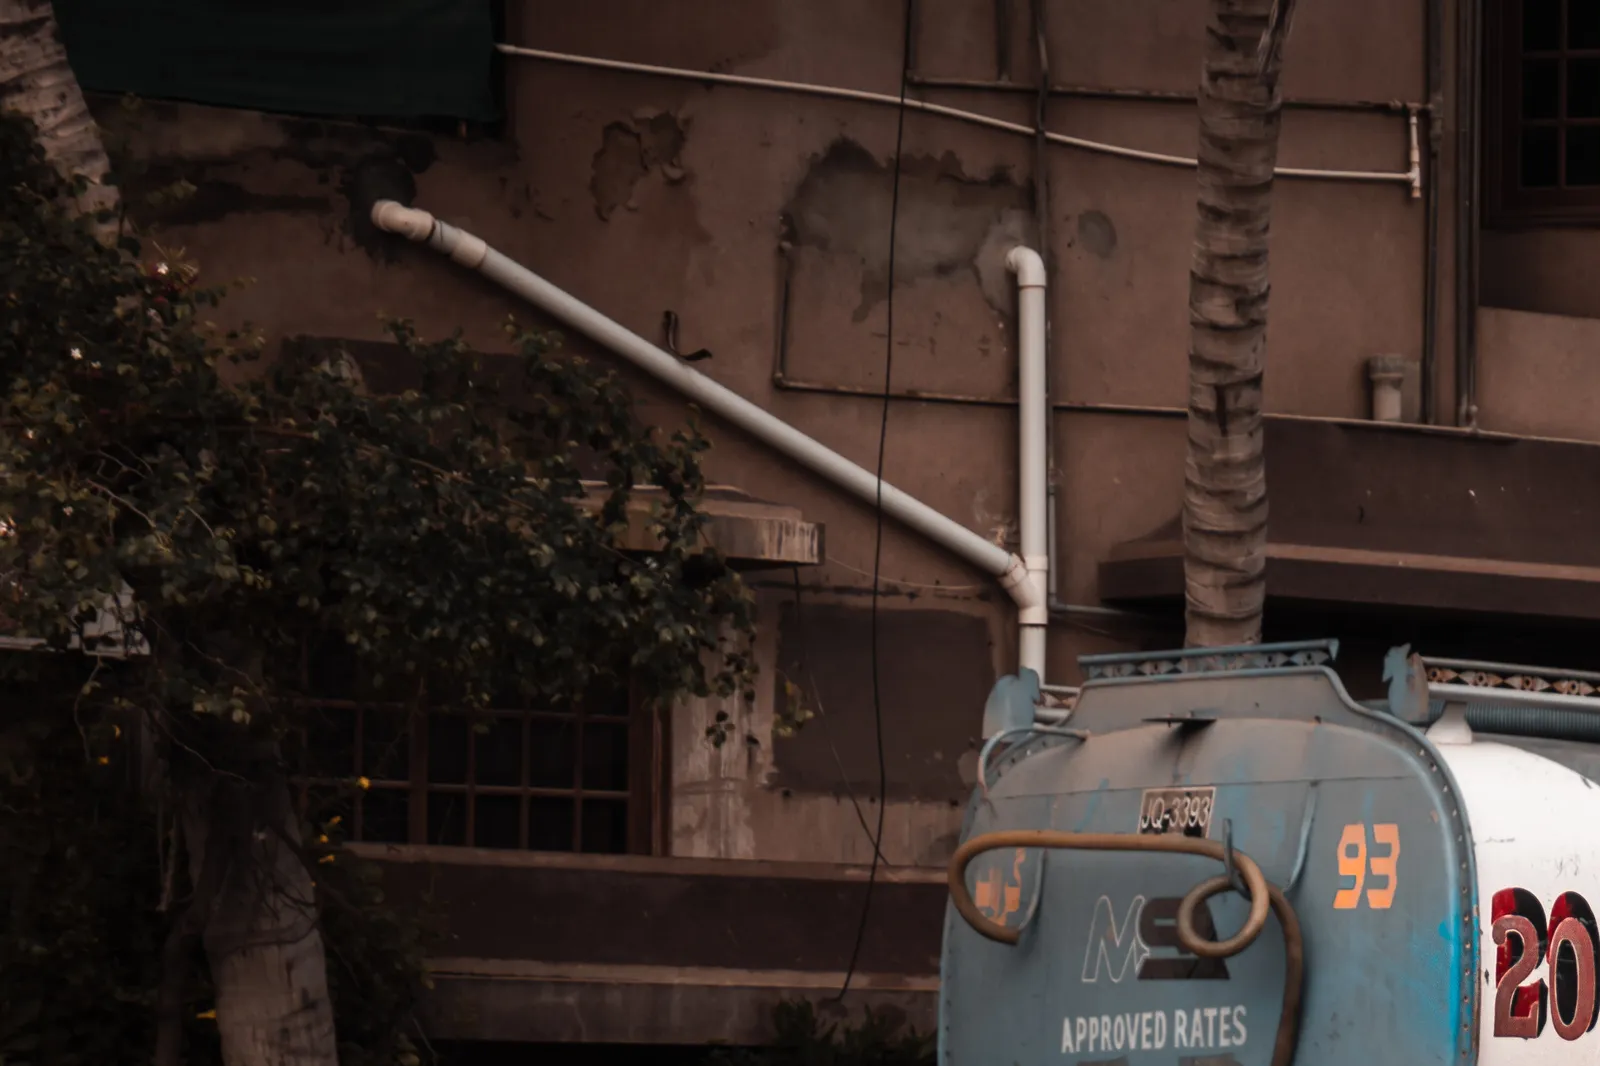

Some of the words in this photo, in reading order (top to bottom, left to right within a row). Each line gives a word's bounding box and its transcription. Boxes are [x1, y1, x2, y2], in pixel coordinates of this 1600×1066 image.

[1141, 796, 1211, 829] JQ-3393
[1333, 823, 1401, 909] 93
[1061, 1010, 1168, 1054] APPROVED
[1174, 1004, 1248, 1048] RATES
